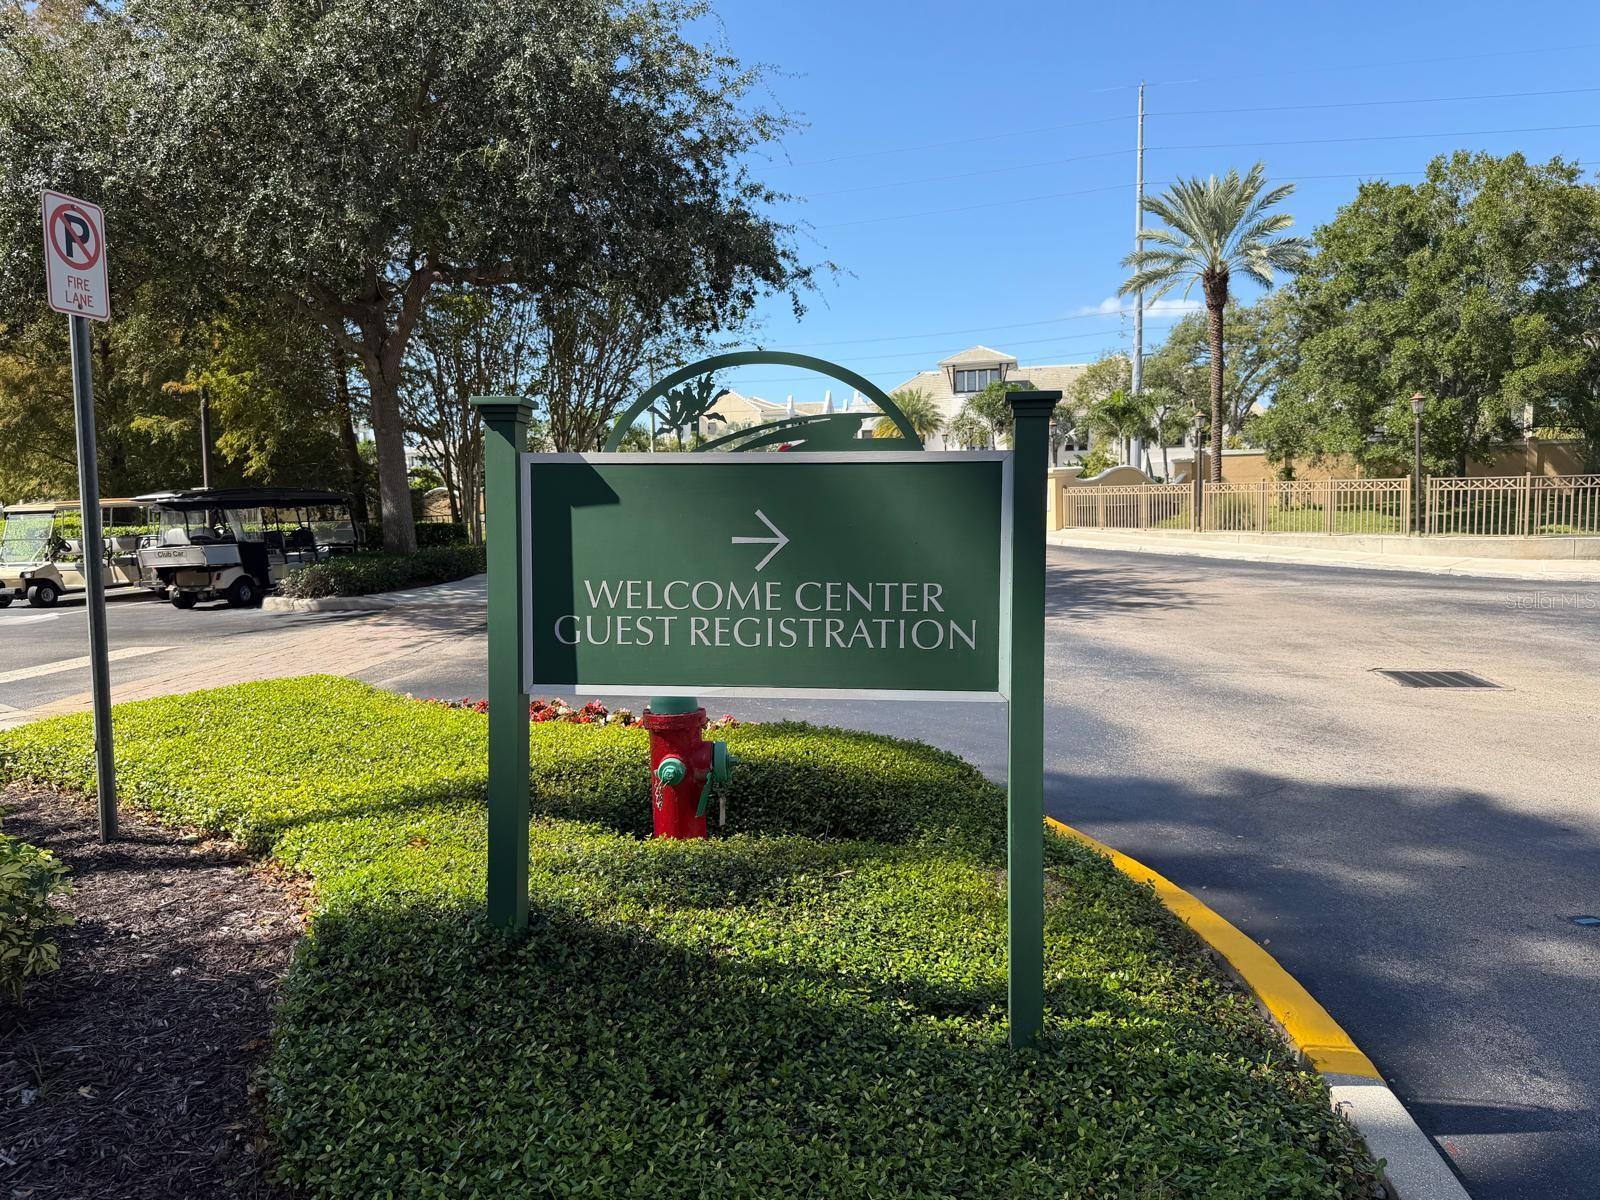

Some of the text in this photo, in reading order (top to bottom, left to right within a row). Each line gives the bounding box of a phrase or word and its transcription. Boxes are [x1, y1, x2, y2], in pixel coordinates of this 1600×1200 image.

[64, 213, 90, 258] P
[67, 275, 91, 292] FIRE
[65, 290, 94, 308] LANE
[172, 550, 184, 558] Car
[584, 580, 945, 612] WELCOME CENTER
[554, 615, 977, 650] GUEST REGISTRATION
